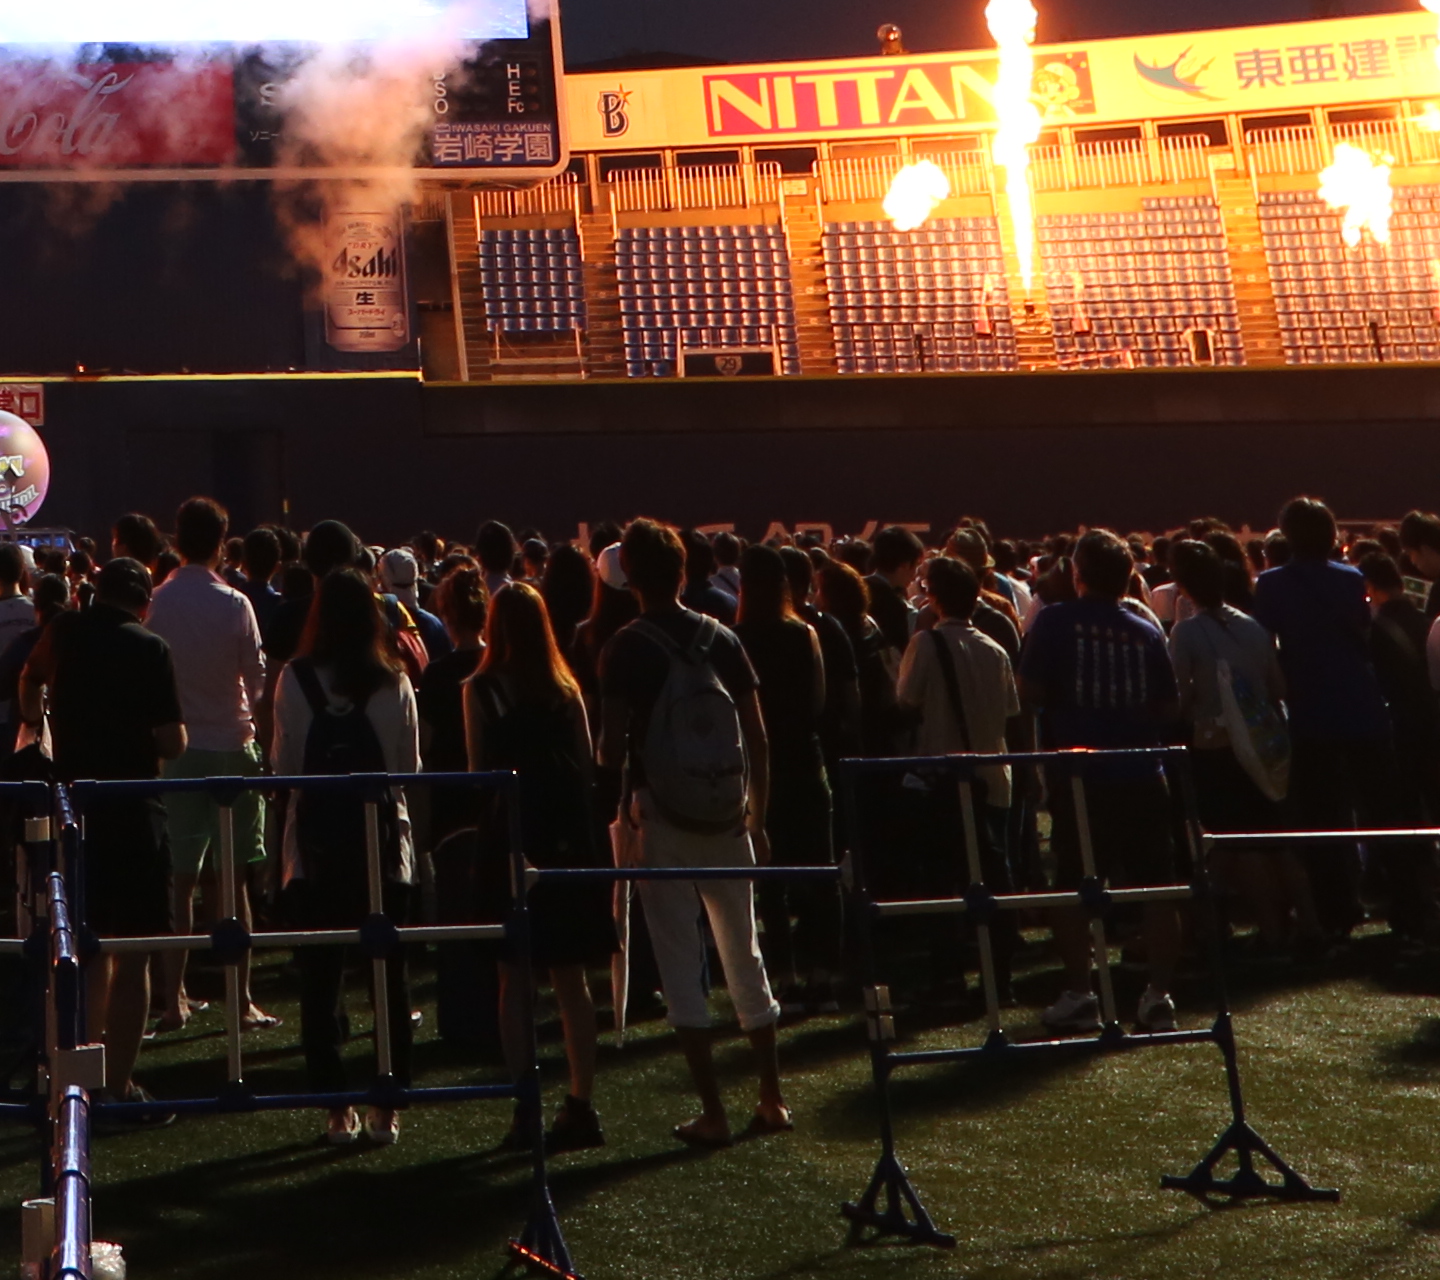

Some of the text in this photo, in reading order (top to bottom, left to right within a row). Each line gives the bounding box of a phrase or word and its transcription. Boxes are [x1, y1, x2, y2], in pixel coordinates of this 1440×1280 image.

[506, 63, 521, 79] H
[508, 80, 522, 96] E
[451, 123, 552, 133] IWASAKI GAKUEN
[433, 132, 553, 163] 岩崎学園
[332, 246, 398, 279] Asahi
[355, 291, 376, 306] 生
